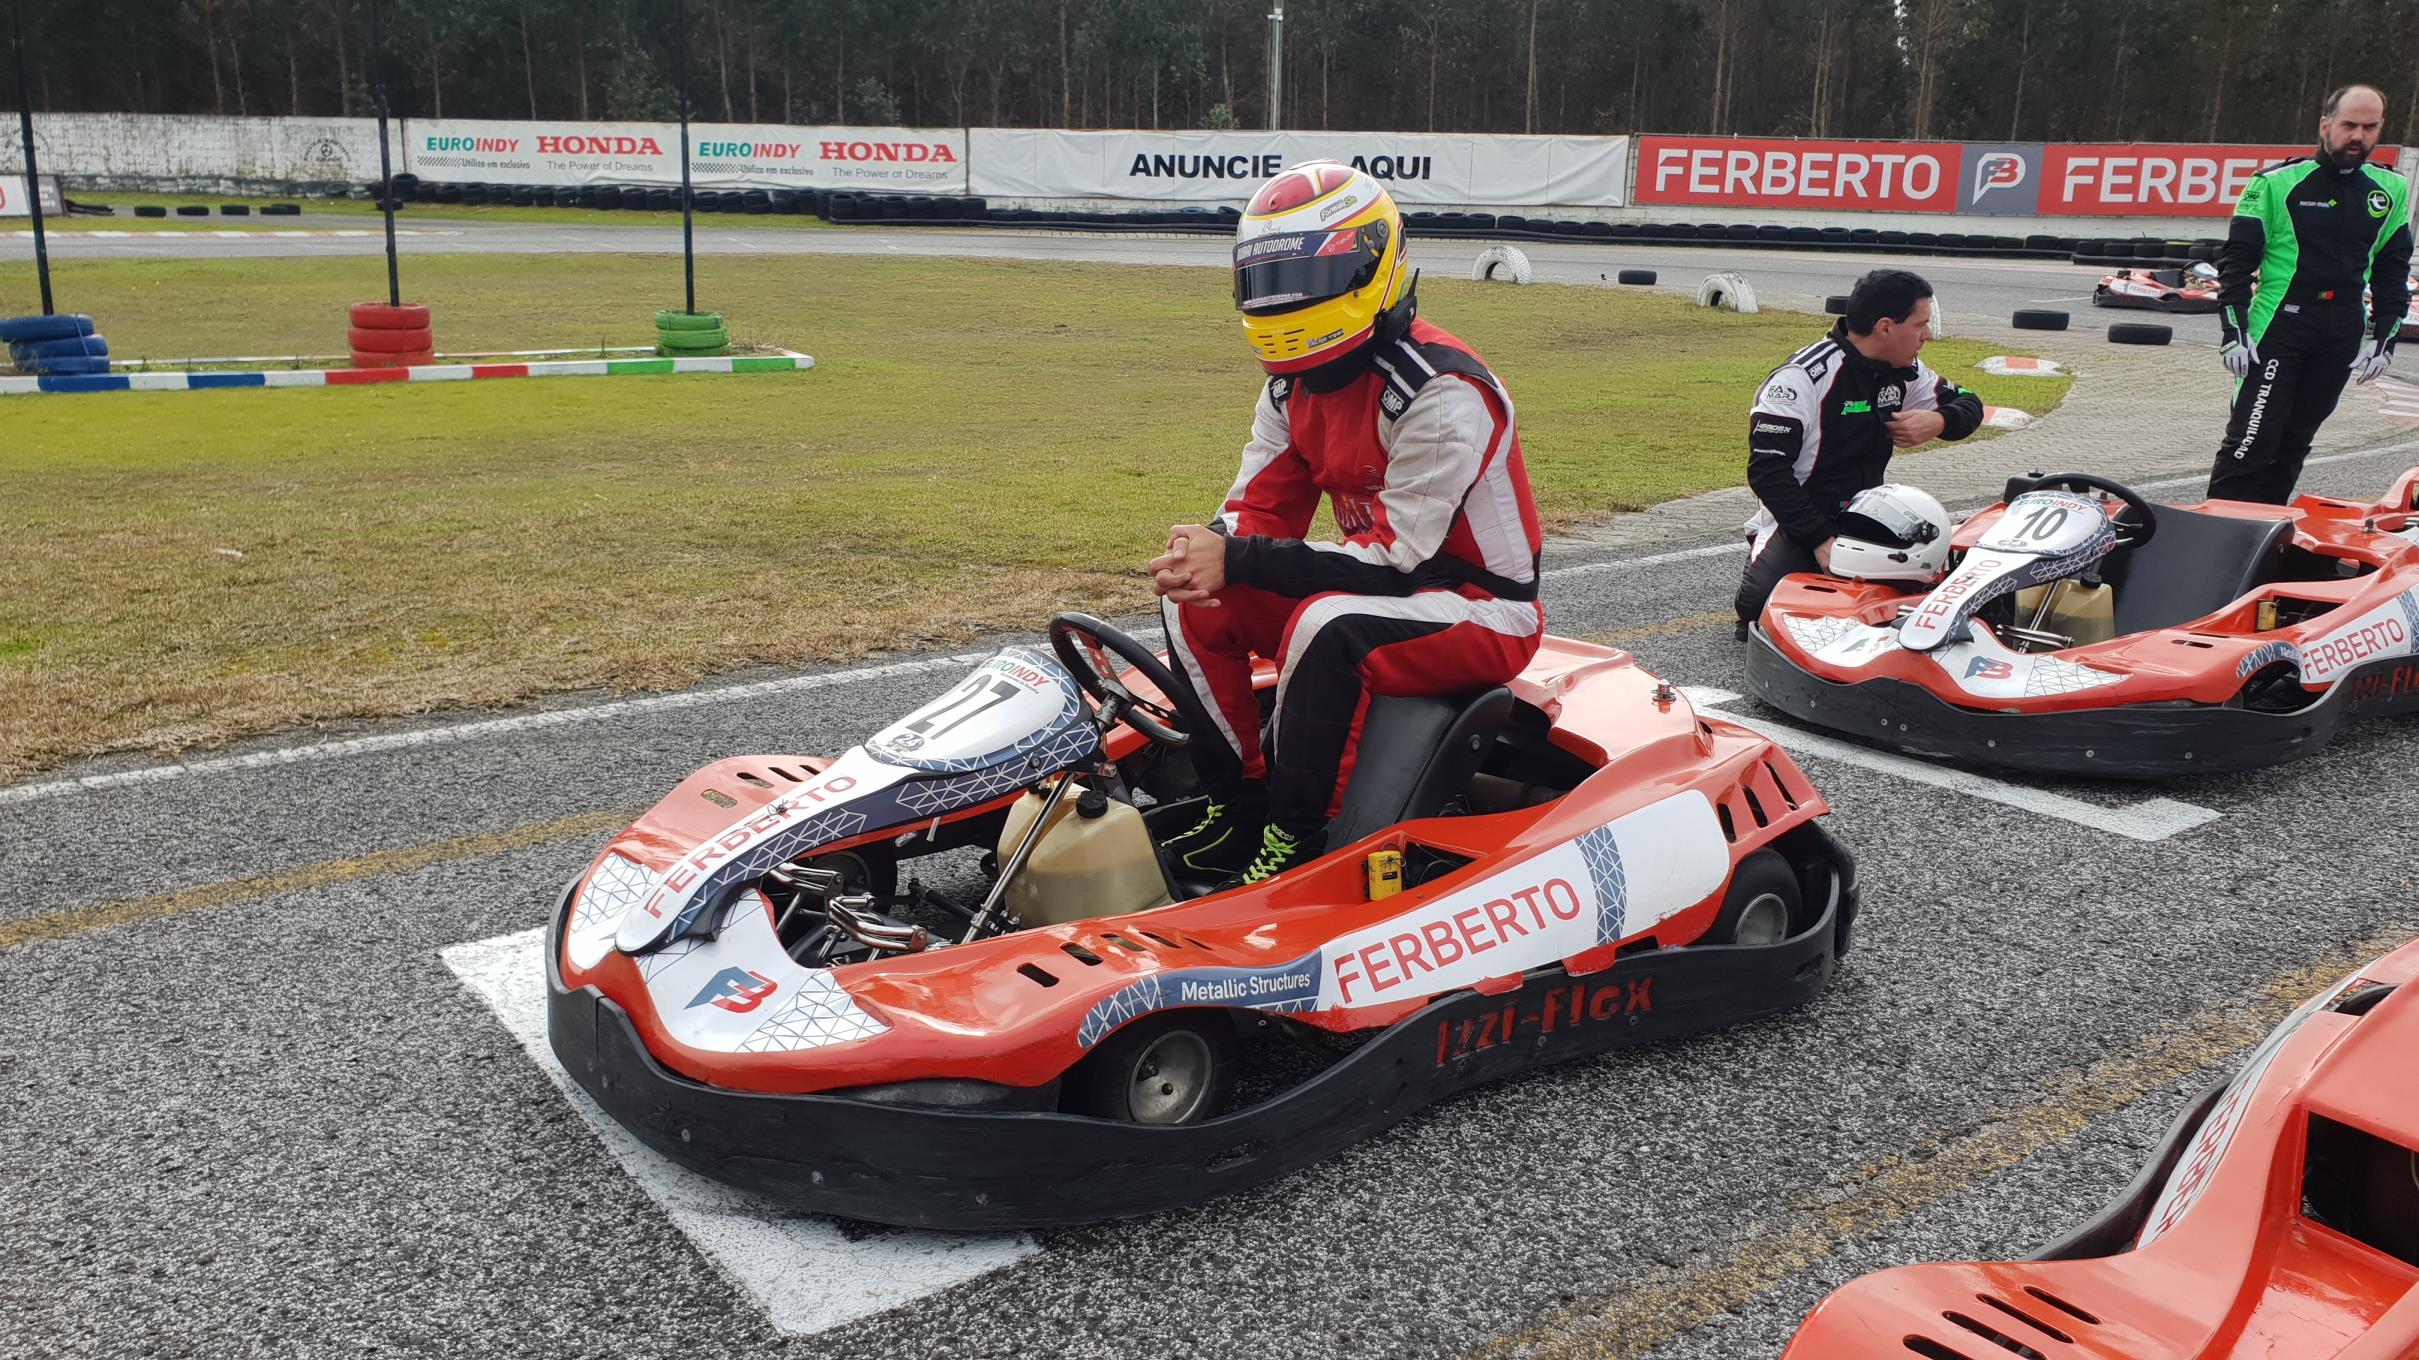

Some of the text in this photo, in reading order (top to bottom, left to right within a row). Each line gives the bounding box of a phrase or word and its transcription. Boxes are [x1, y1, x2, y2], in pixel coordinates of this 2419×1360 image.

[426, 136, 520, 153] EUROINDY
[535, 135, 664, 156] HONDA
[698, 141, 801, 159] EUROINDY
[818, 141, 958, 163] HONDA
[487, 161, 499, 169] em
[500, 160, 531, 170] exclusivo
[546, 160, 654, 172] The Power of Dreams
[766, 168, 778, 176] em
[779, 166, 814, 176] exclusivo
[831, 167, 948, 180] The Power of Dreams
[1129, 153, 1432, 181] ANUNCIE AQUI
[1656, 149, 1941, 200] FERBERTO
[2064, 157, 2284, 204] FERBE
[1252, 237, 1305, 257] AUTODROME
[2264, 358, 2279, 381] CCD
[1382, 388, 1405, 415] OMP
[2233, 383, 2273, 460] TRANQUILIDAD
[2013, 506, 2069, 541] 10
[1914, 559, 2003, 631] FERBERTO
[2302, 618, 2404, 681] FERBERTO
[905, 673, 1022, 741] 27
[643, 775, 858, 920] FERBERTO
[1333, 877, 1582, 1004] FERBERTO
[1181, 972, 1311, 1001] Metallic Structures
